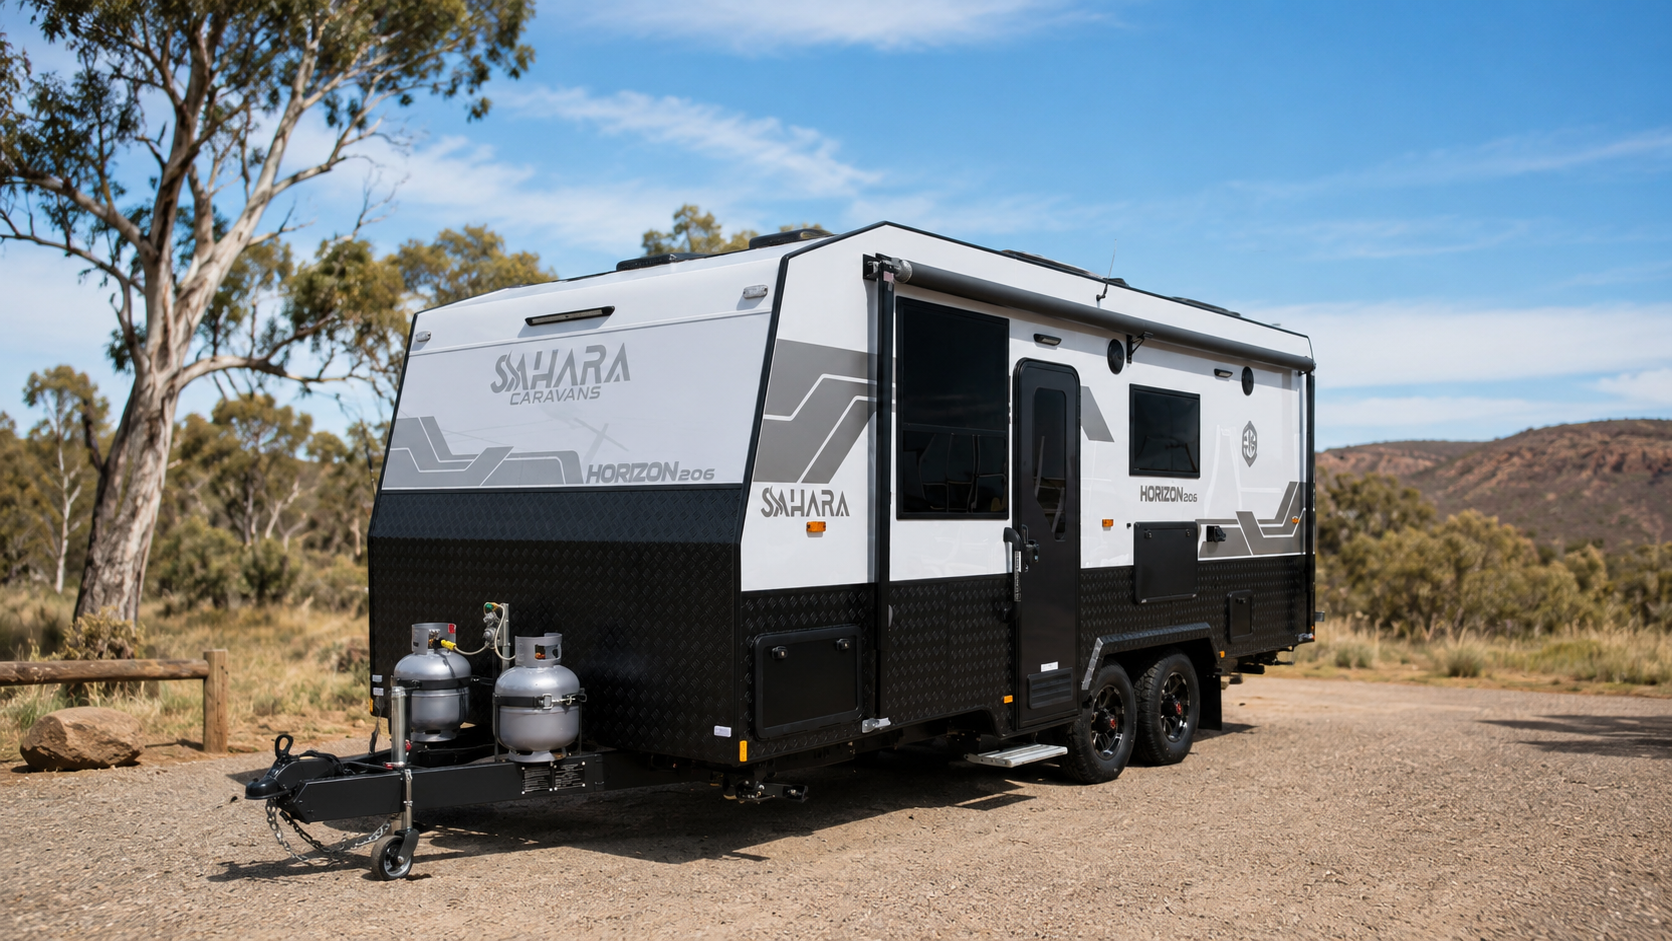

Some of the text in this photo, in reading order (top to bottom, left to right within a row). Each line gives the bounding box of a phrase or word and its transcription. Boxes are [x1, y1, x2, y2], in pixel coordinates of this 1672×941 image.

[490, 342, 631, 394] SAHARA
[509, 386, 602, 406] CARAVANS
[760, 485, 850, 518] SAHARA
